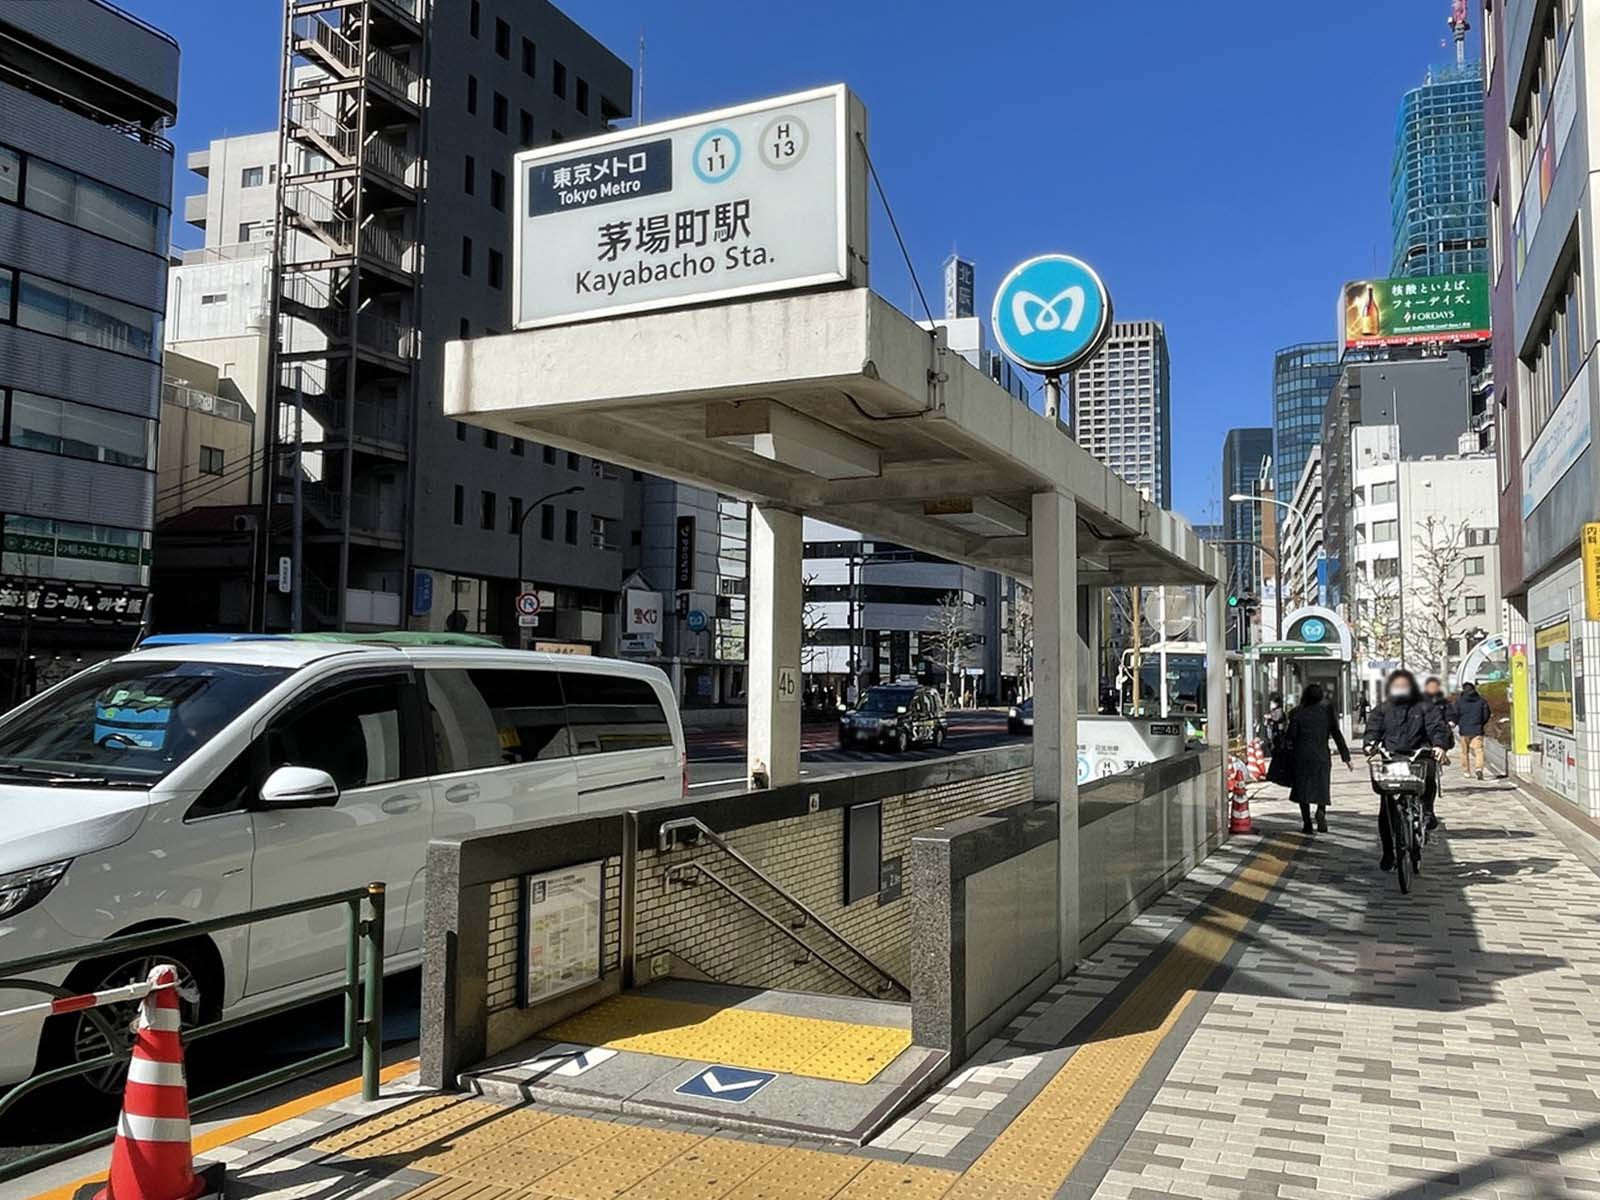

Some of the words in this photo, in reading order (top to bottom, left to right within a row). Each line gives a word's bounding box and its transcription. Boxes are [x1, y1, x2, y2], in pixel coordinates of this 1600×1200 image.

[777, 124, 790, 139] H
[712, 138, 721, 153] T
[773, 141, 795, 159] 13
[553, 152, 647, 189] 東京メトロ
[707, 155, 727, 172] 11
[558, 187, 598, 205] Tokyo
[600, 179, 641, 198] Metro
[598, 199, 751, 262] 茅場町駅
[576, 253, 715, 296] Kayabacho
[726, 246, 775, 270] Sta.
[1391, 280, 1471, 296] 核酸といえば、
[1413, 310, 1455, 322] FORDAYS
[779, 672, 795, 696] 4b
